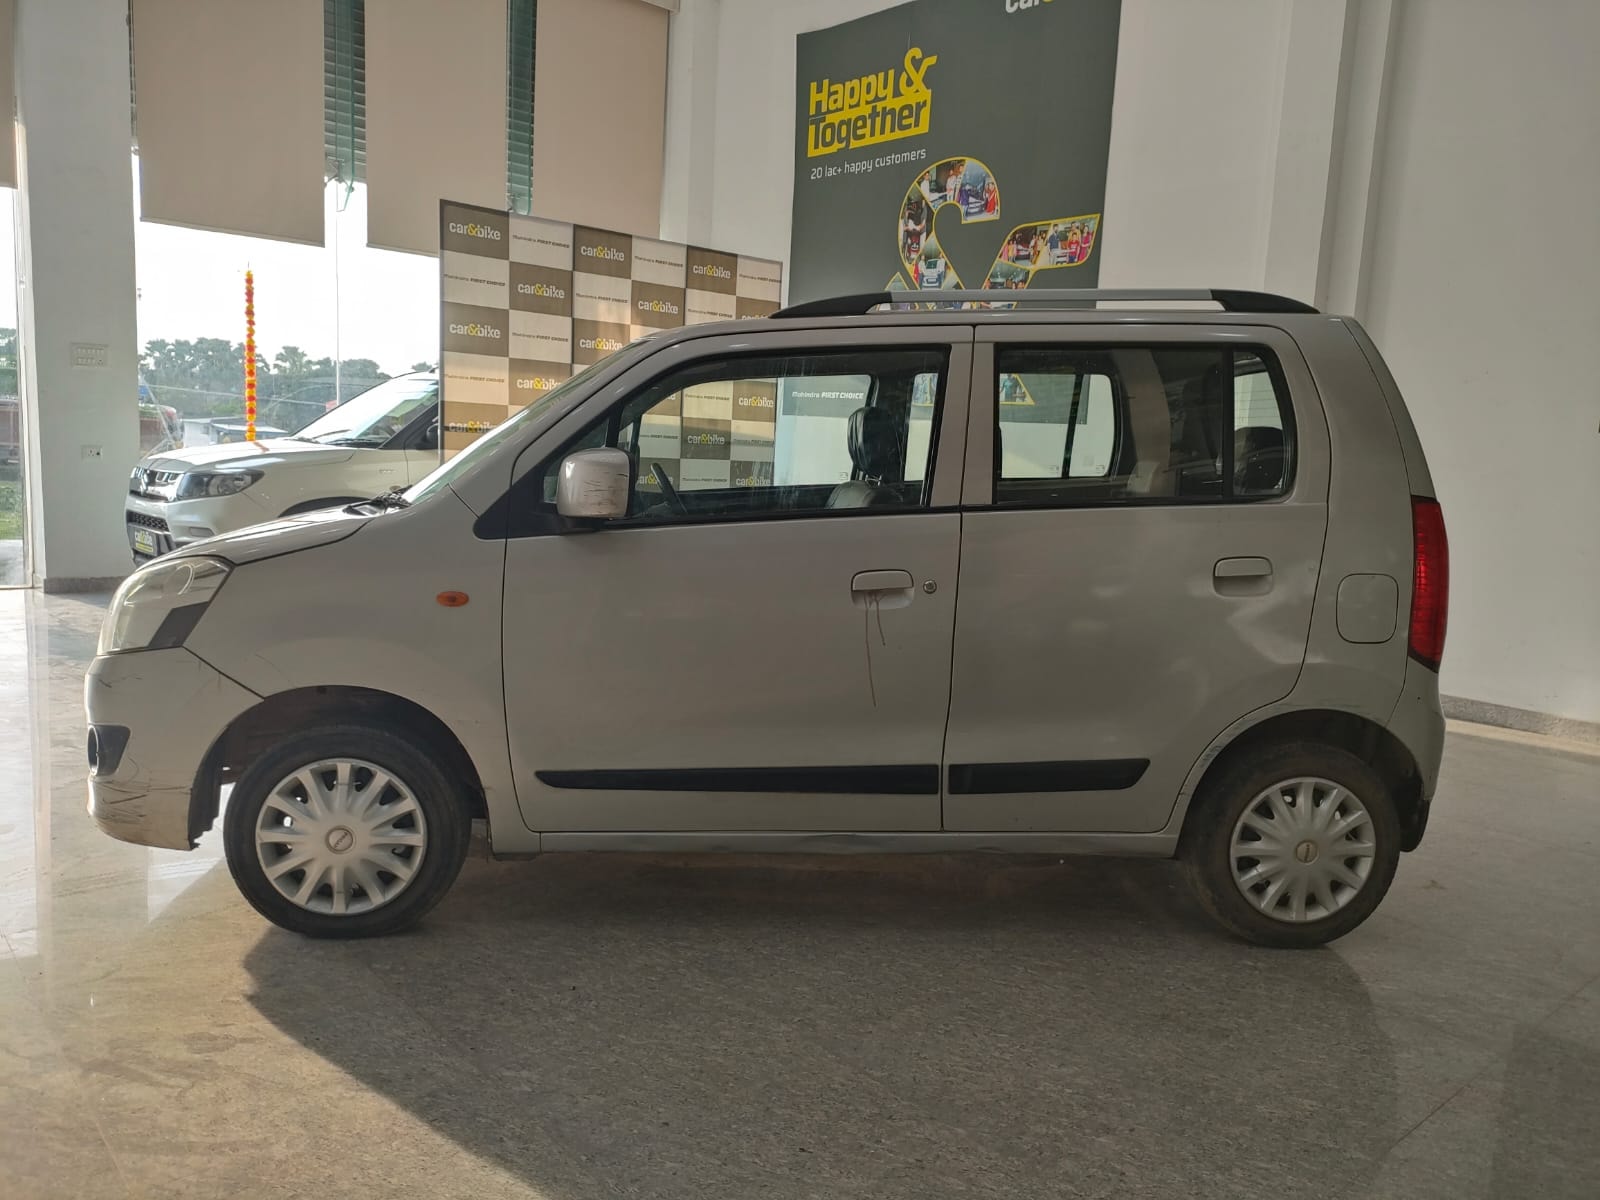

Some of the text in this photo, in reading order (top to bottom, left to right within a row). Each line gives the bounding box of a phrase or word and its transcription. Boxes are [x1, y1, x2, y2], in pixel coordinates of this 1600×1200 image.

[809, 47, 938, 115] Happy &
[809, 99, 927, 150] Together
[810, 148, 926, 180] 20 lac+ happy customers
[449, 222, 501, 241] car&bike
[581, 246, 625, 262] car&bike
[692, 264, 731, 279] car&bike
[517, 283, 565, 299] car&bike
[638, 300, 679, 314] car&bike
[449, 323, 501, 339] car&bike
[738, 396, 774, 408] car&bike
[821, 391, 839, 399] FIRST
[839, 391, 864, 400] CHOICE
[687, 434, 725, 445] car&bike
